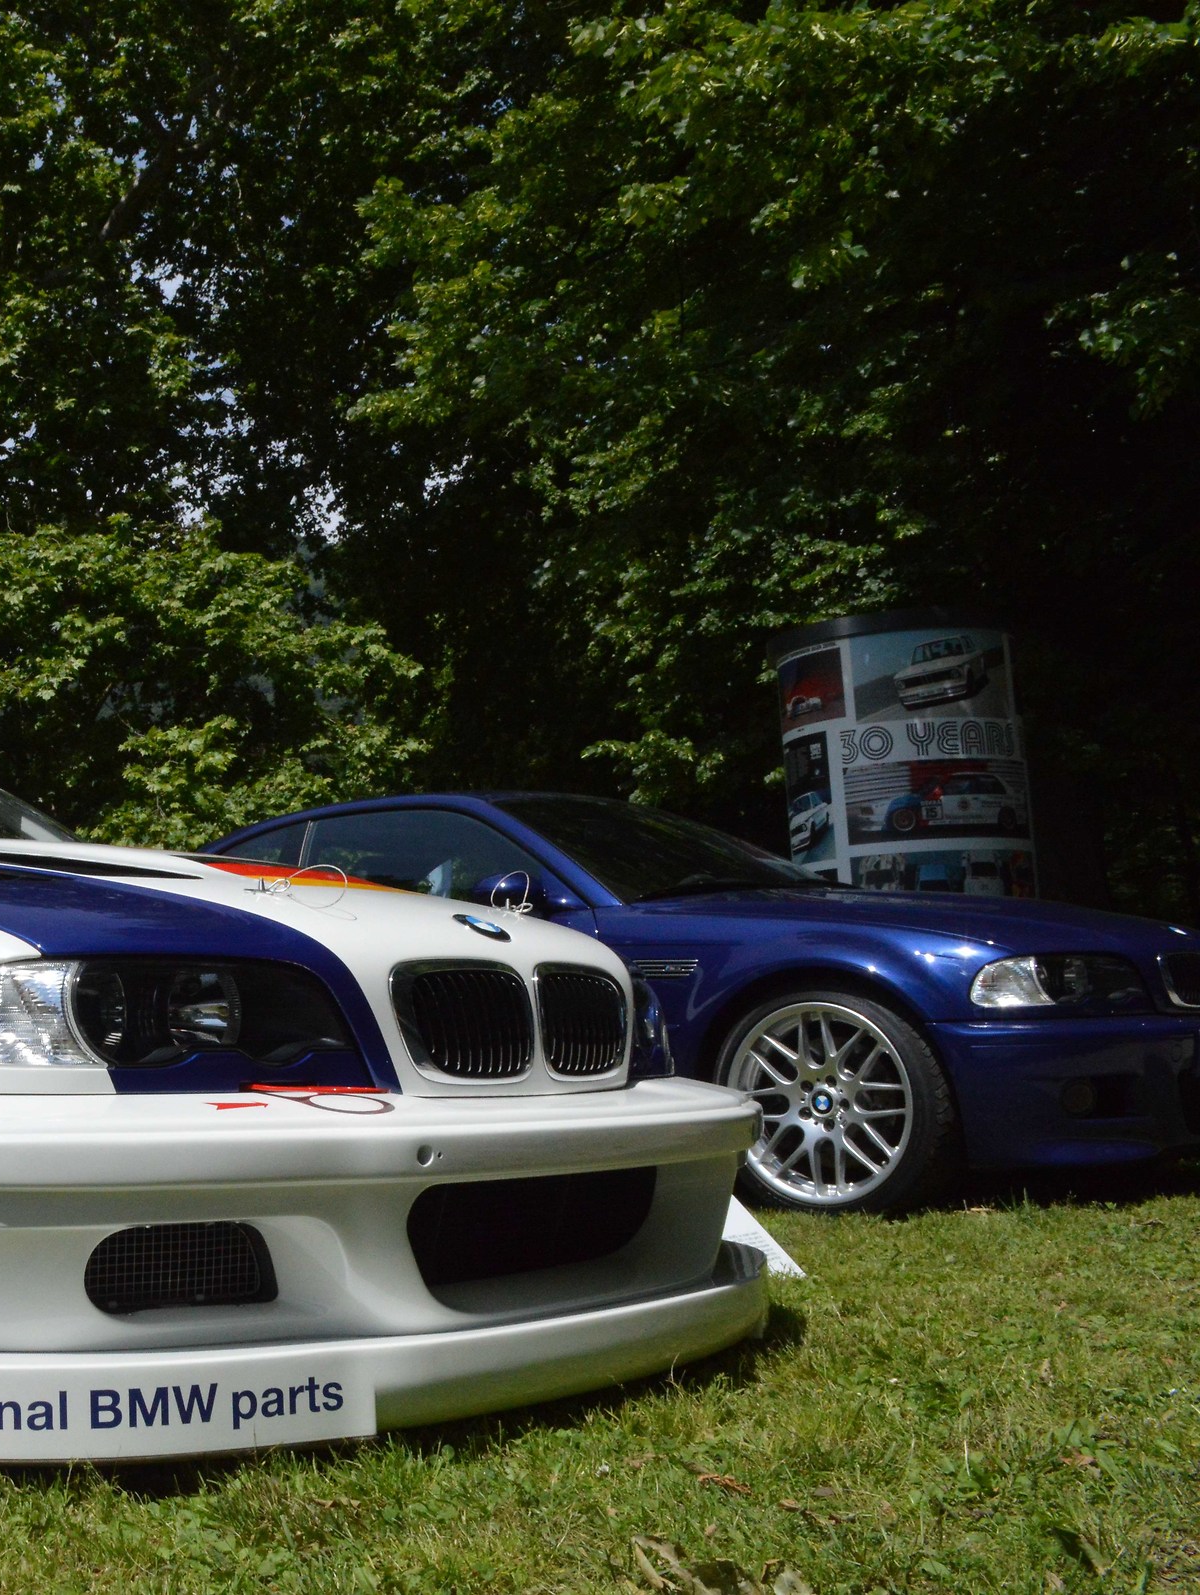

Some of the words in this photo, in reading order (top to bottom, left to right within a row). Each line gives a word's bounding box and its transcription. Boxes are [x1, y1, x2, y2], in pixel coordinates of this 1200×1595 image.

[840, 726, 893, 764] 30
[906, 720, 1014, 757] YEARS
[90, 1383, 217, 1430] BMW
[232, 1376, 344, 1430] parts
